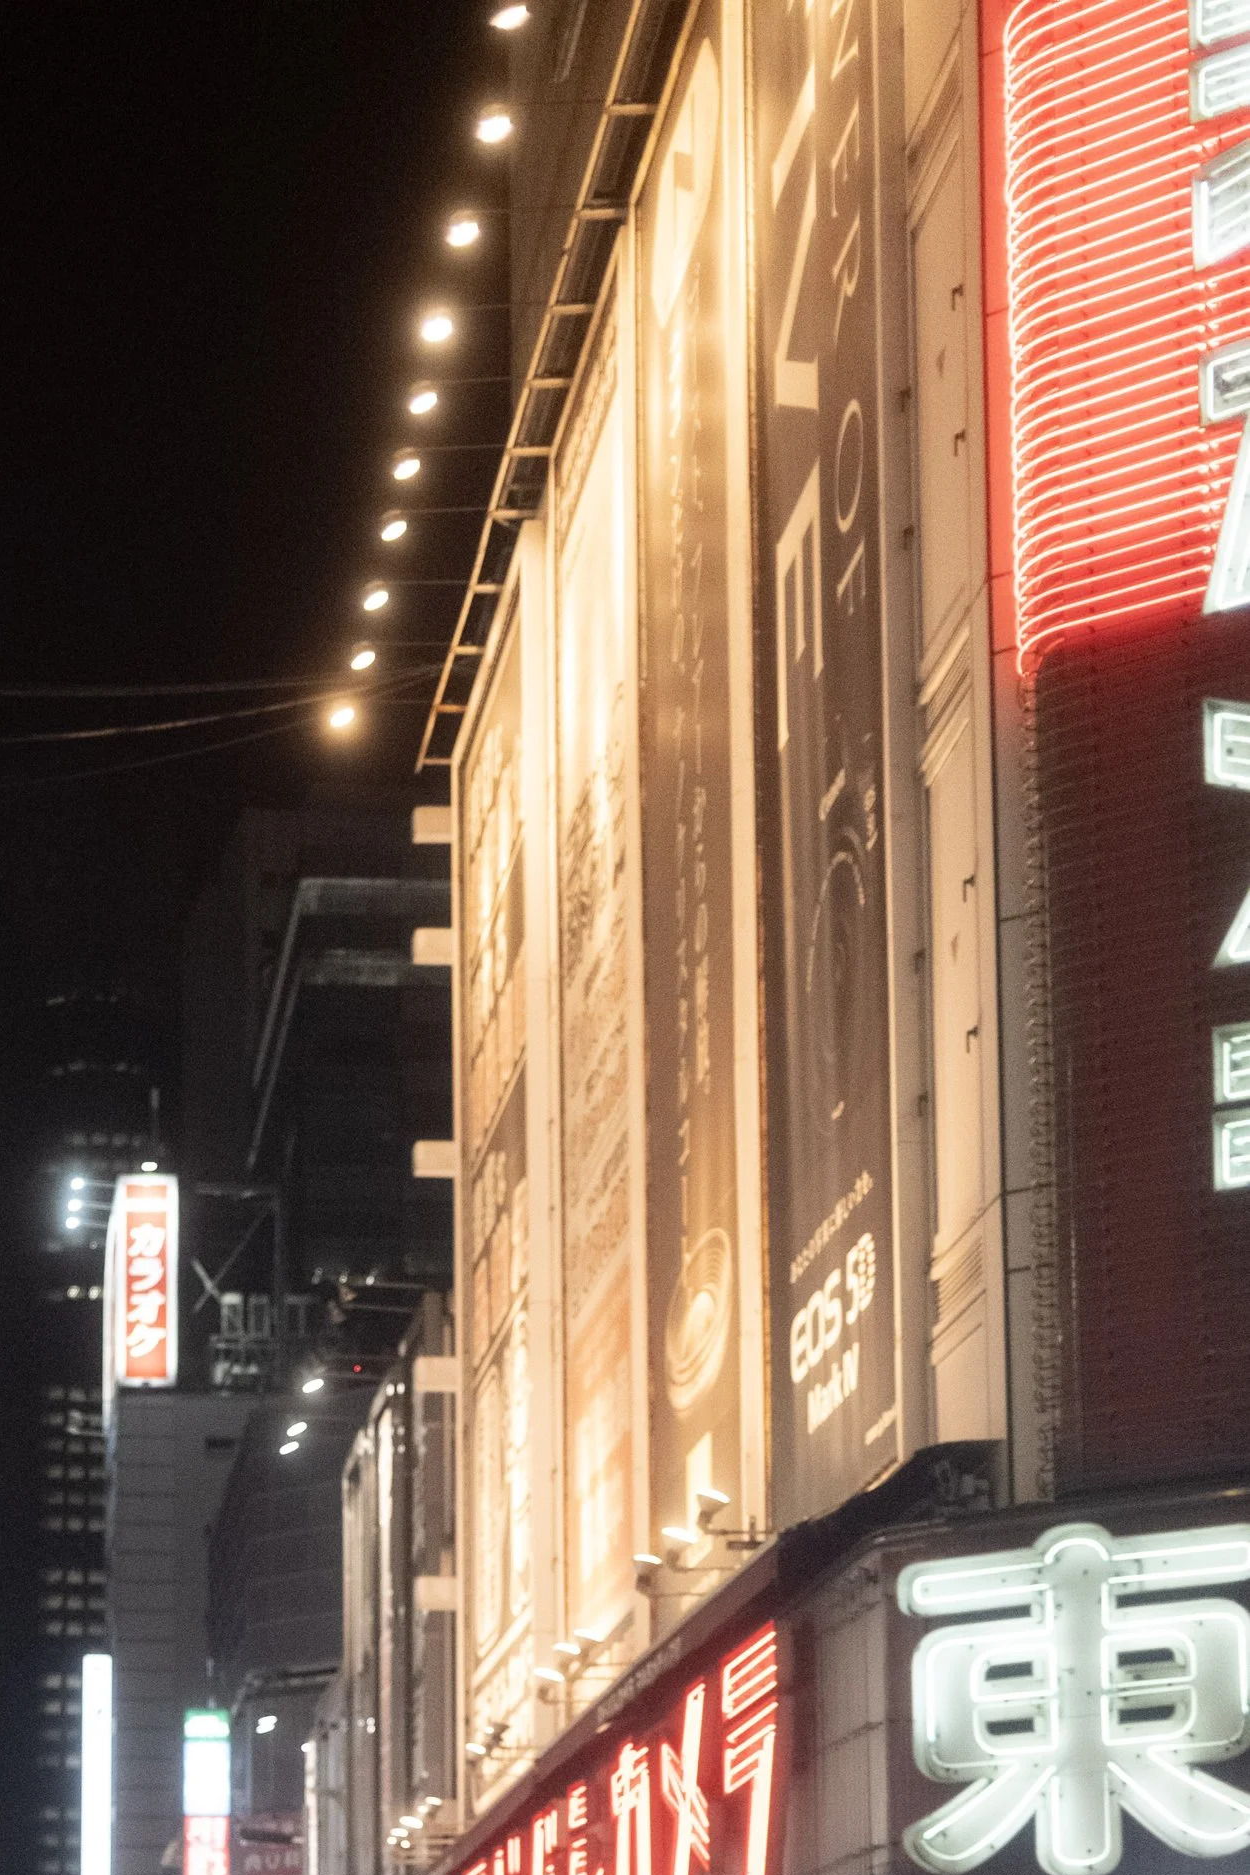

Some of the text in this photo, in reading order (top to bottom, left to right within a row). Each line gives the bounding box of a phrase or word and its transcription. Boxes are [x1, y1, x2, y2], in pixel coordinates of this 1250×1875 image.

[127, 1222, 167, 1358] カラオケ
[791, 1268, 842, 1383] EOS
